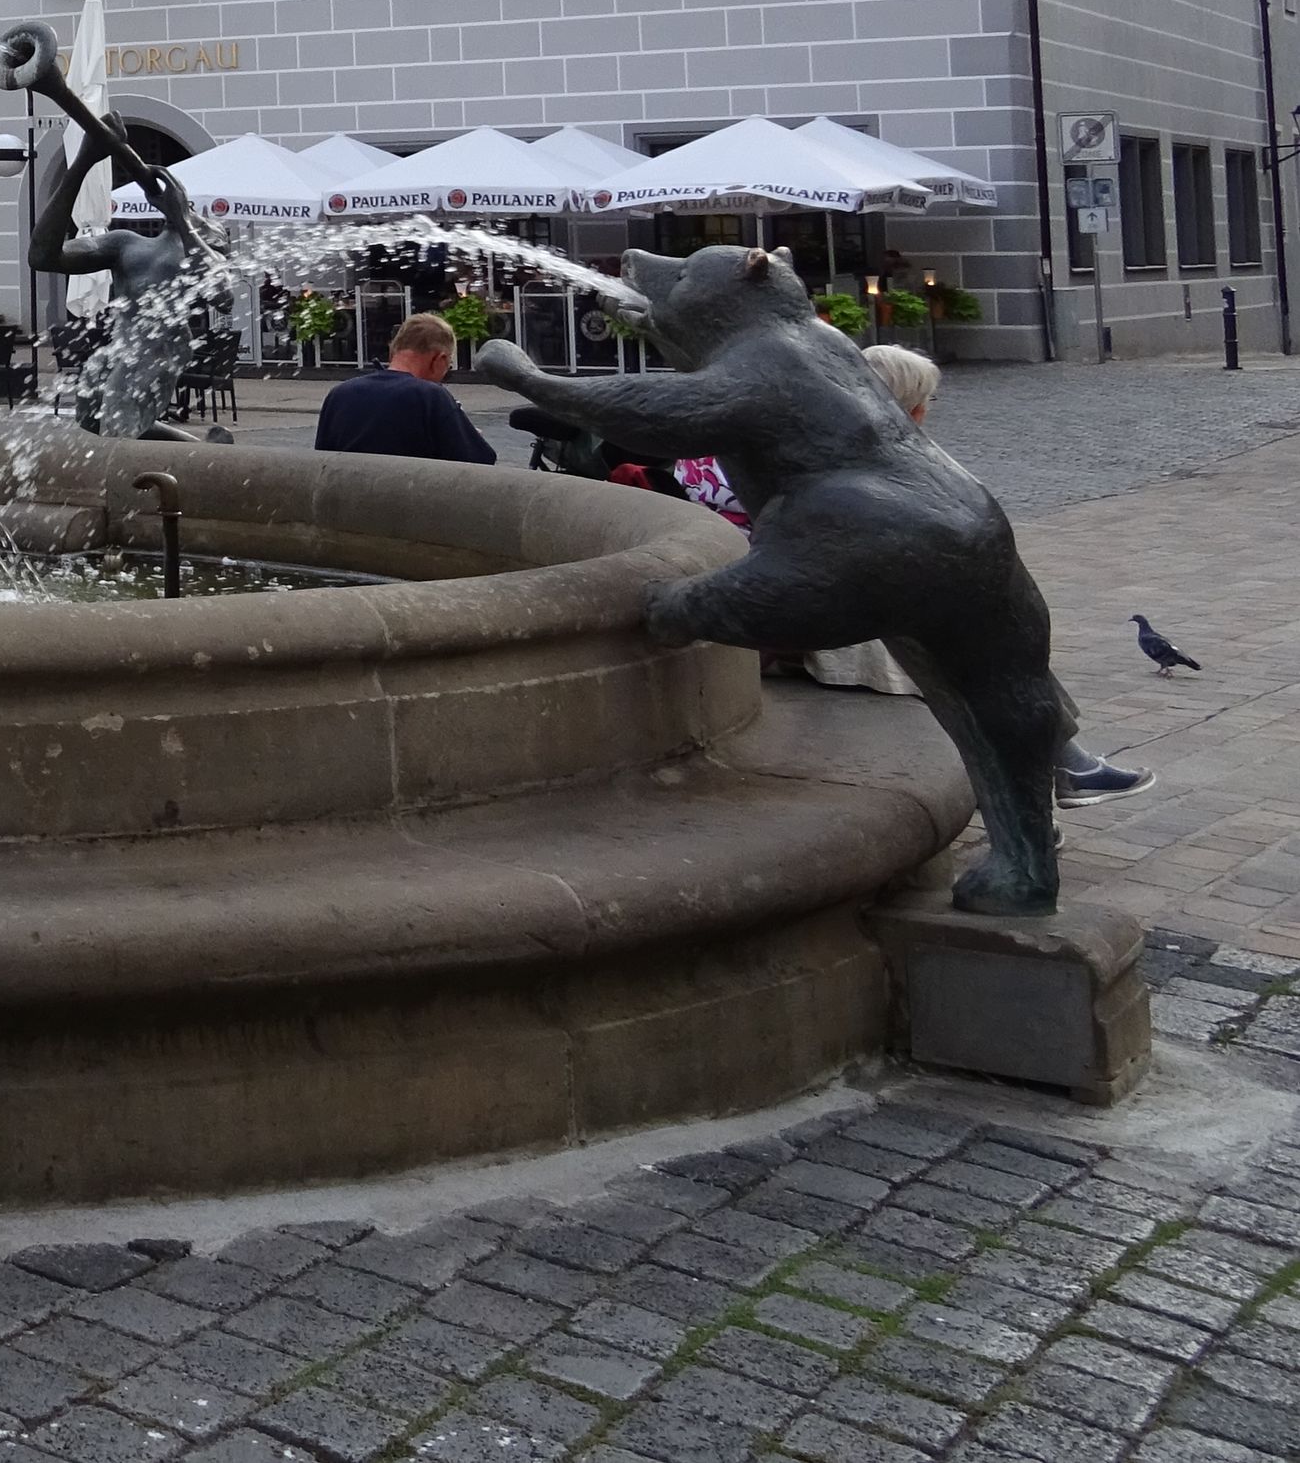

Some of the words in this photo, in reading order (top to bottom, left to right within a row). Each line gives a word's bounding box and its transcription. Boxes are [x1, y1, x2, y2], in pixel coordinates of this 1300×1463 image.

[106, 42, 239, 76] TORGAU
[352, 192, 431, 209] PAULANER
[472, 192, 557, 207] PAULANER
[617, 186, 706, 202] PAULANER
[121, 200, 196, 214] PAULR
[233, 202, 311, 218] PAULANER
